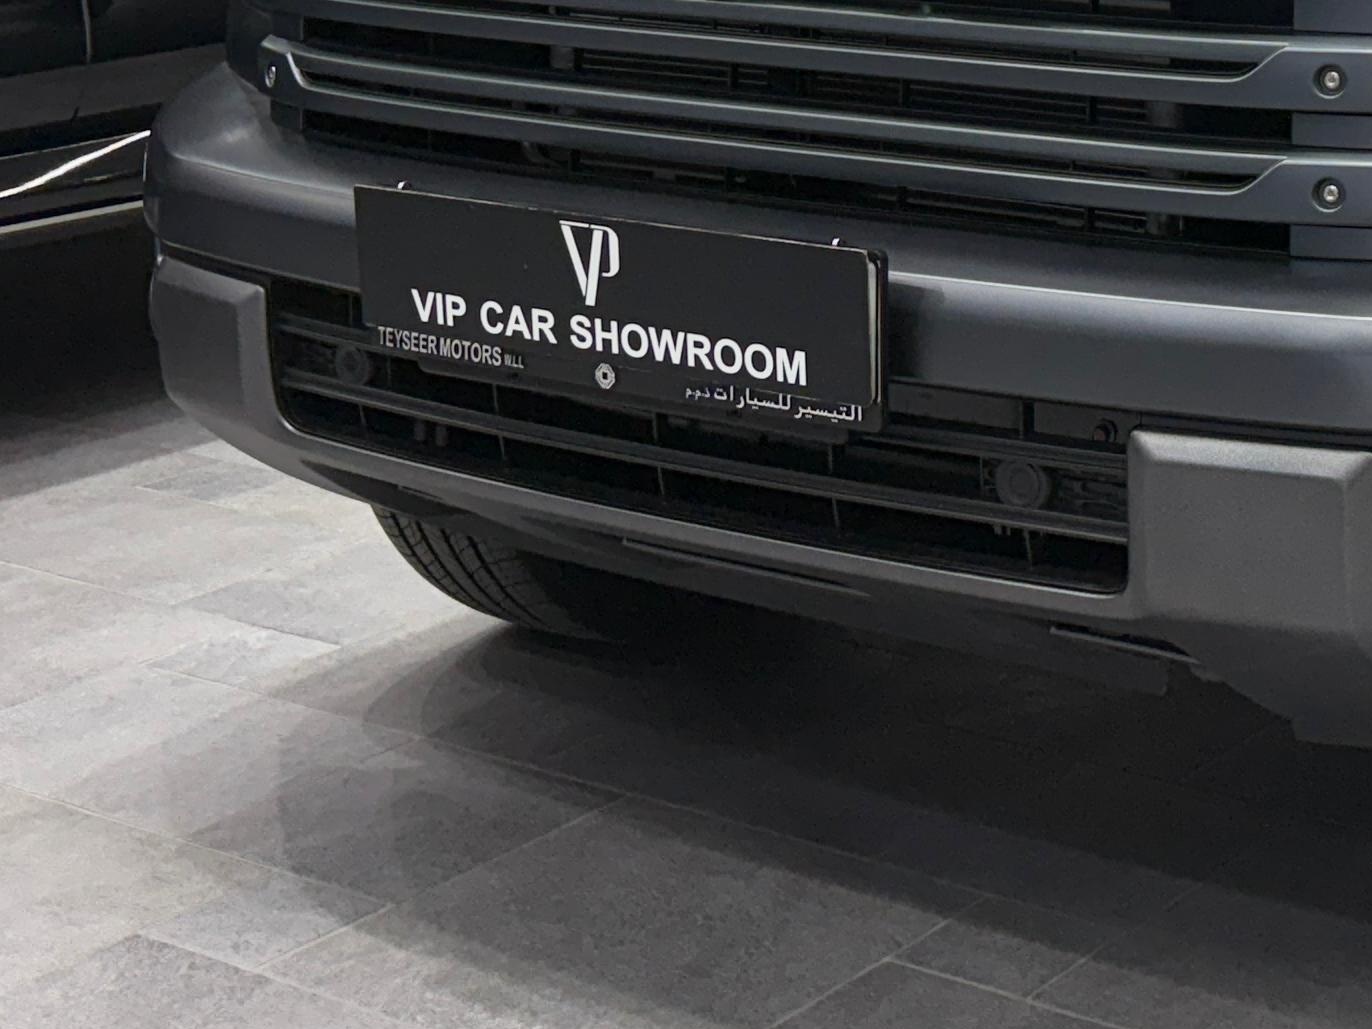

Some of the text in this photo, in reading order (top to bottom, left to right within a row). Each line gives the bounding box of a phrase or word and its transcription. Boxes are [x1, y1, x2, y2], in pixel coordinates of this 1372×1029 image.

[378, 326, 438, 356] TEYSEER
[439, 338, 502, 367] MOTORS
[411, 288, 808, 386] VIP CAR SHOWROOM
[713, 385, 792, 411] للسيارات
[794, 404, 863, 423] التيسير
